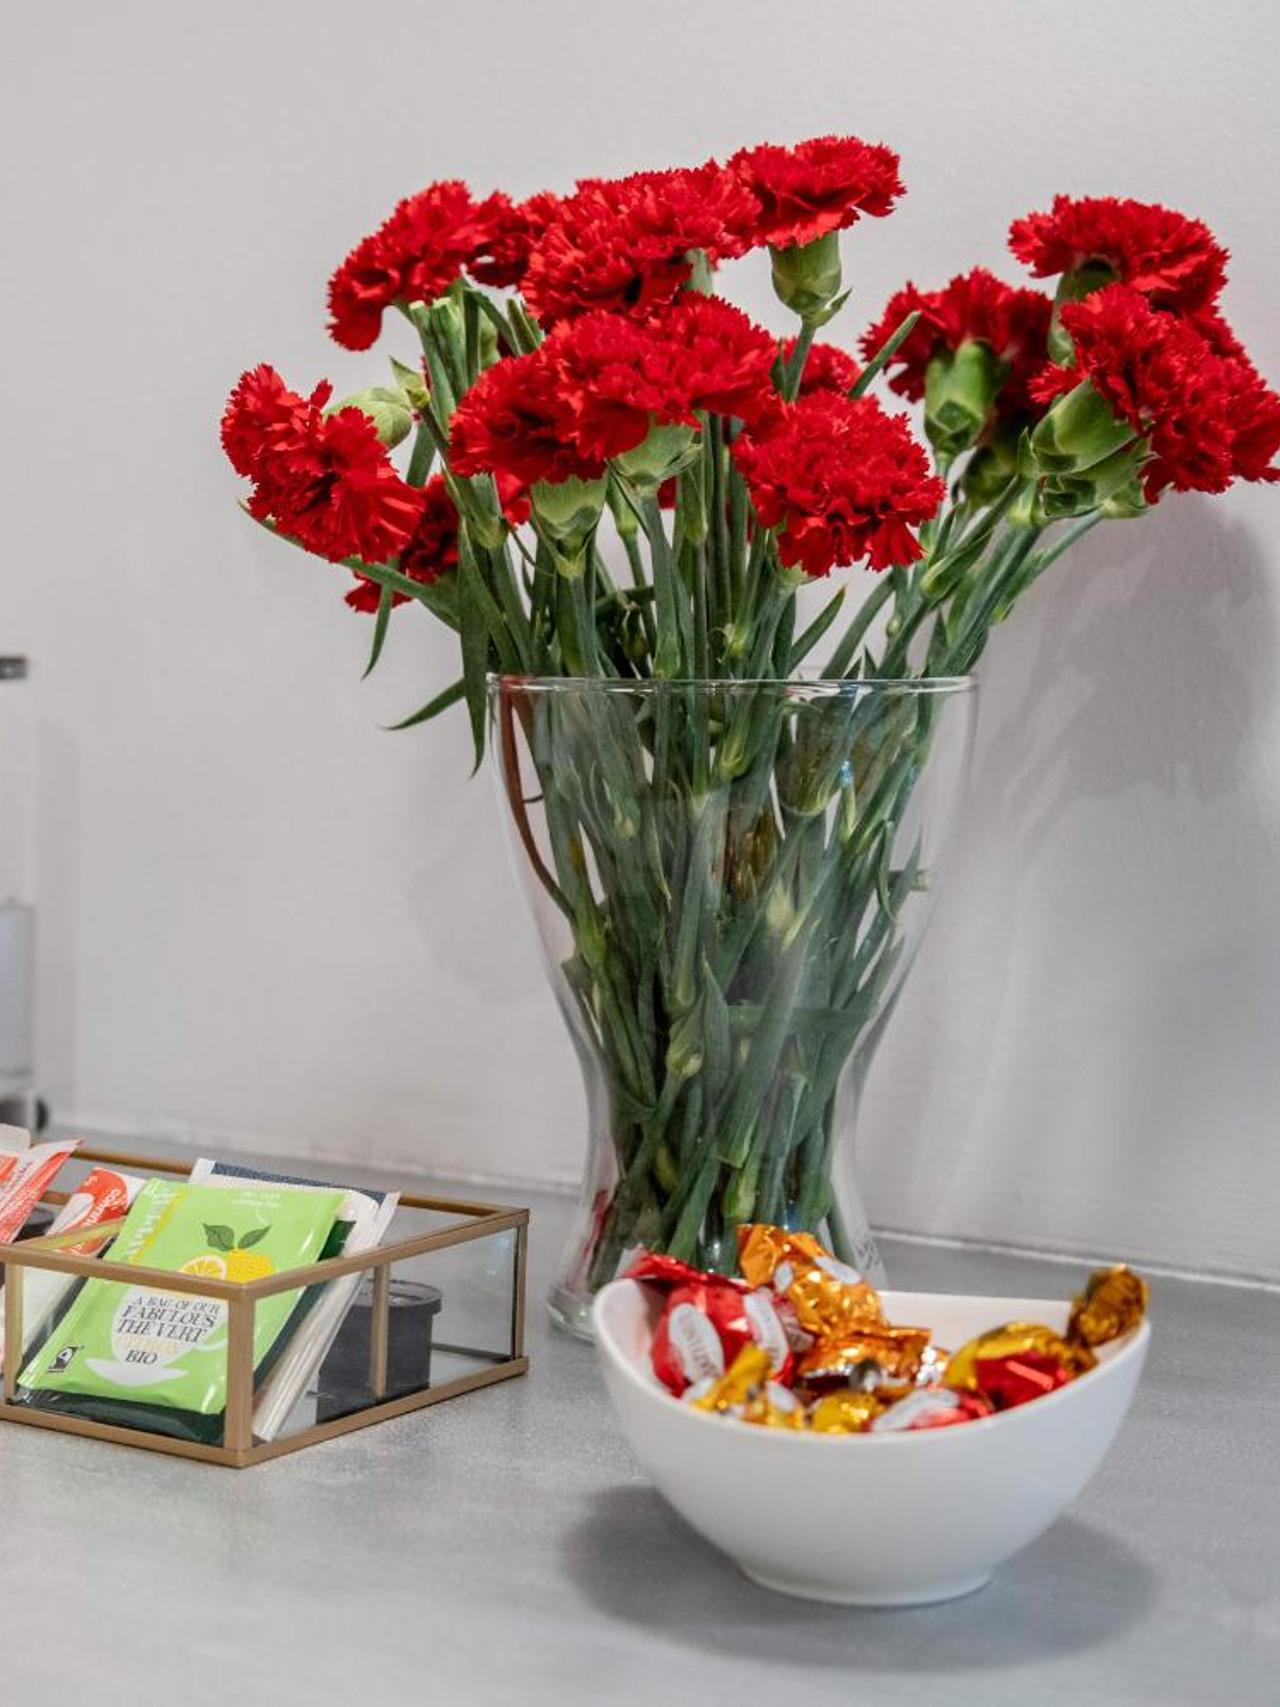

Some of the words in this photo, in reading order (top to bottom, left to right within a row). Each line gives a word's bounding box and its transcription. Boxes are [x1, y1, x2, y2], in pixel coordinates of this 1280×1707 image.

[132, 1296, 143, 1306] A
[147, 1297, 170, 1308] BAG
[175, 1299, 191, 1310] OF
[193, 1301, 221, 1314] OUR
[122, 1305, 218, 1328] FABULOUS
[157, 1322, 208, 1343] VERT
[125, 1349, 159, 1365] BIO
